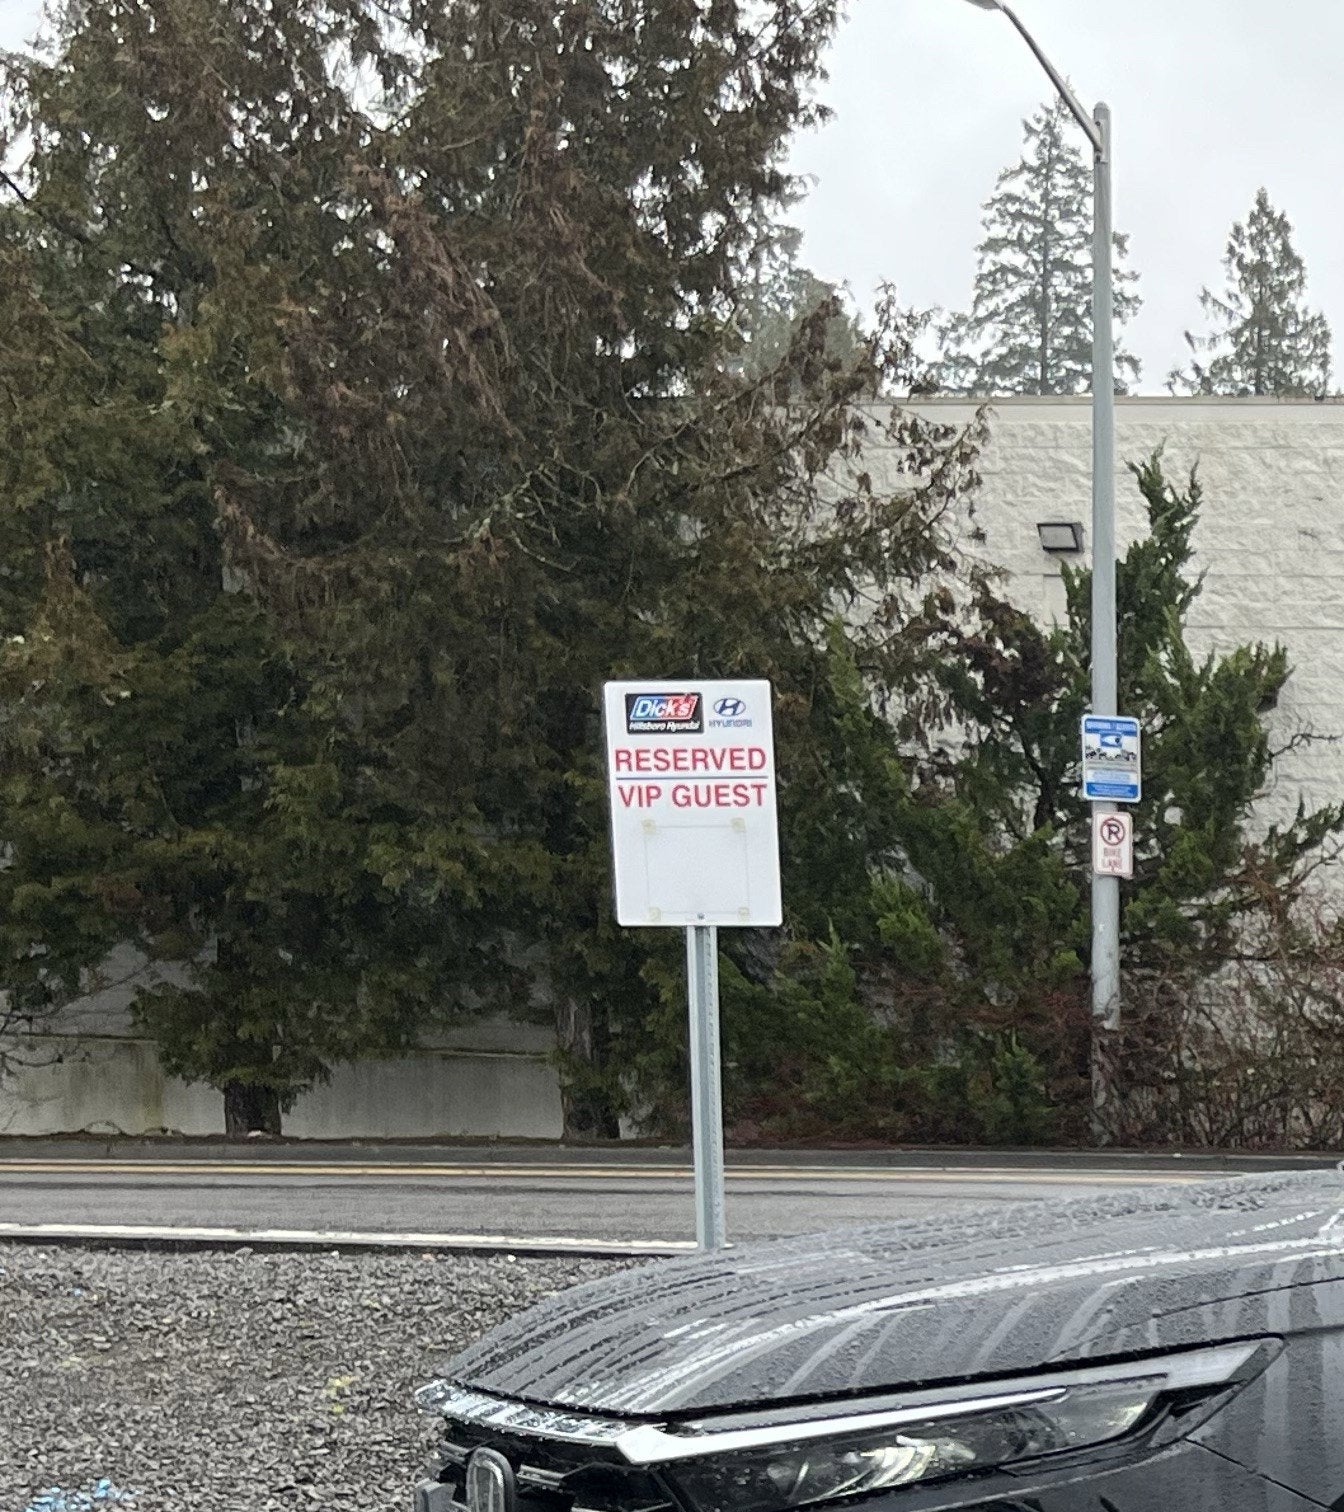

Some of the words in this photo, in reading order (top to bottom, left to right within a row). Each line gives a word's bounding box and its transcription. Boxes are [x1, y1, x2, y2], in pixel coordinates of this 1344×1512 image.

[614, 747, 767, 773] RESERVED
[617, 784, 663, 808] VIP
[671, 783, 768, 808] GUEST
